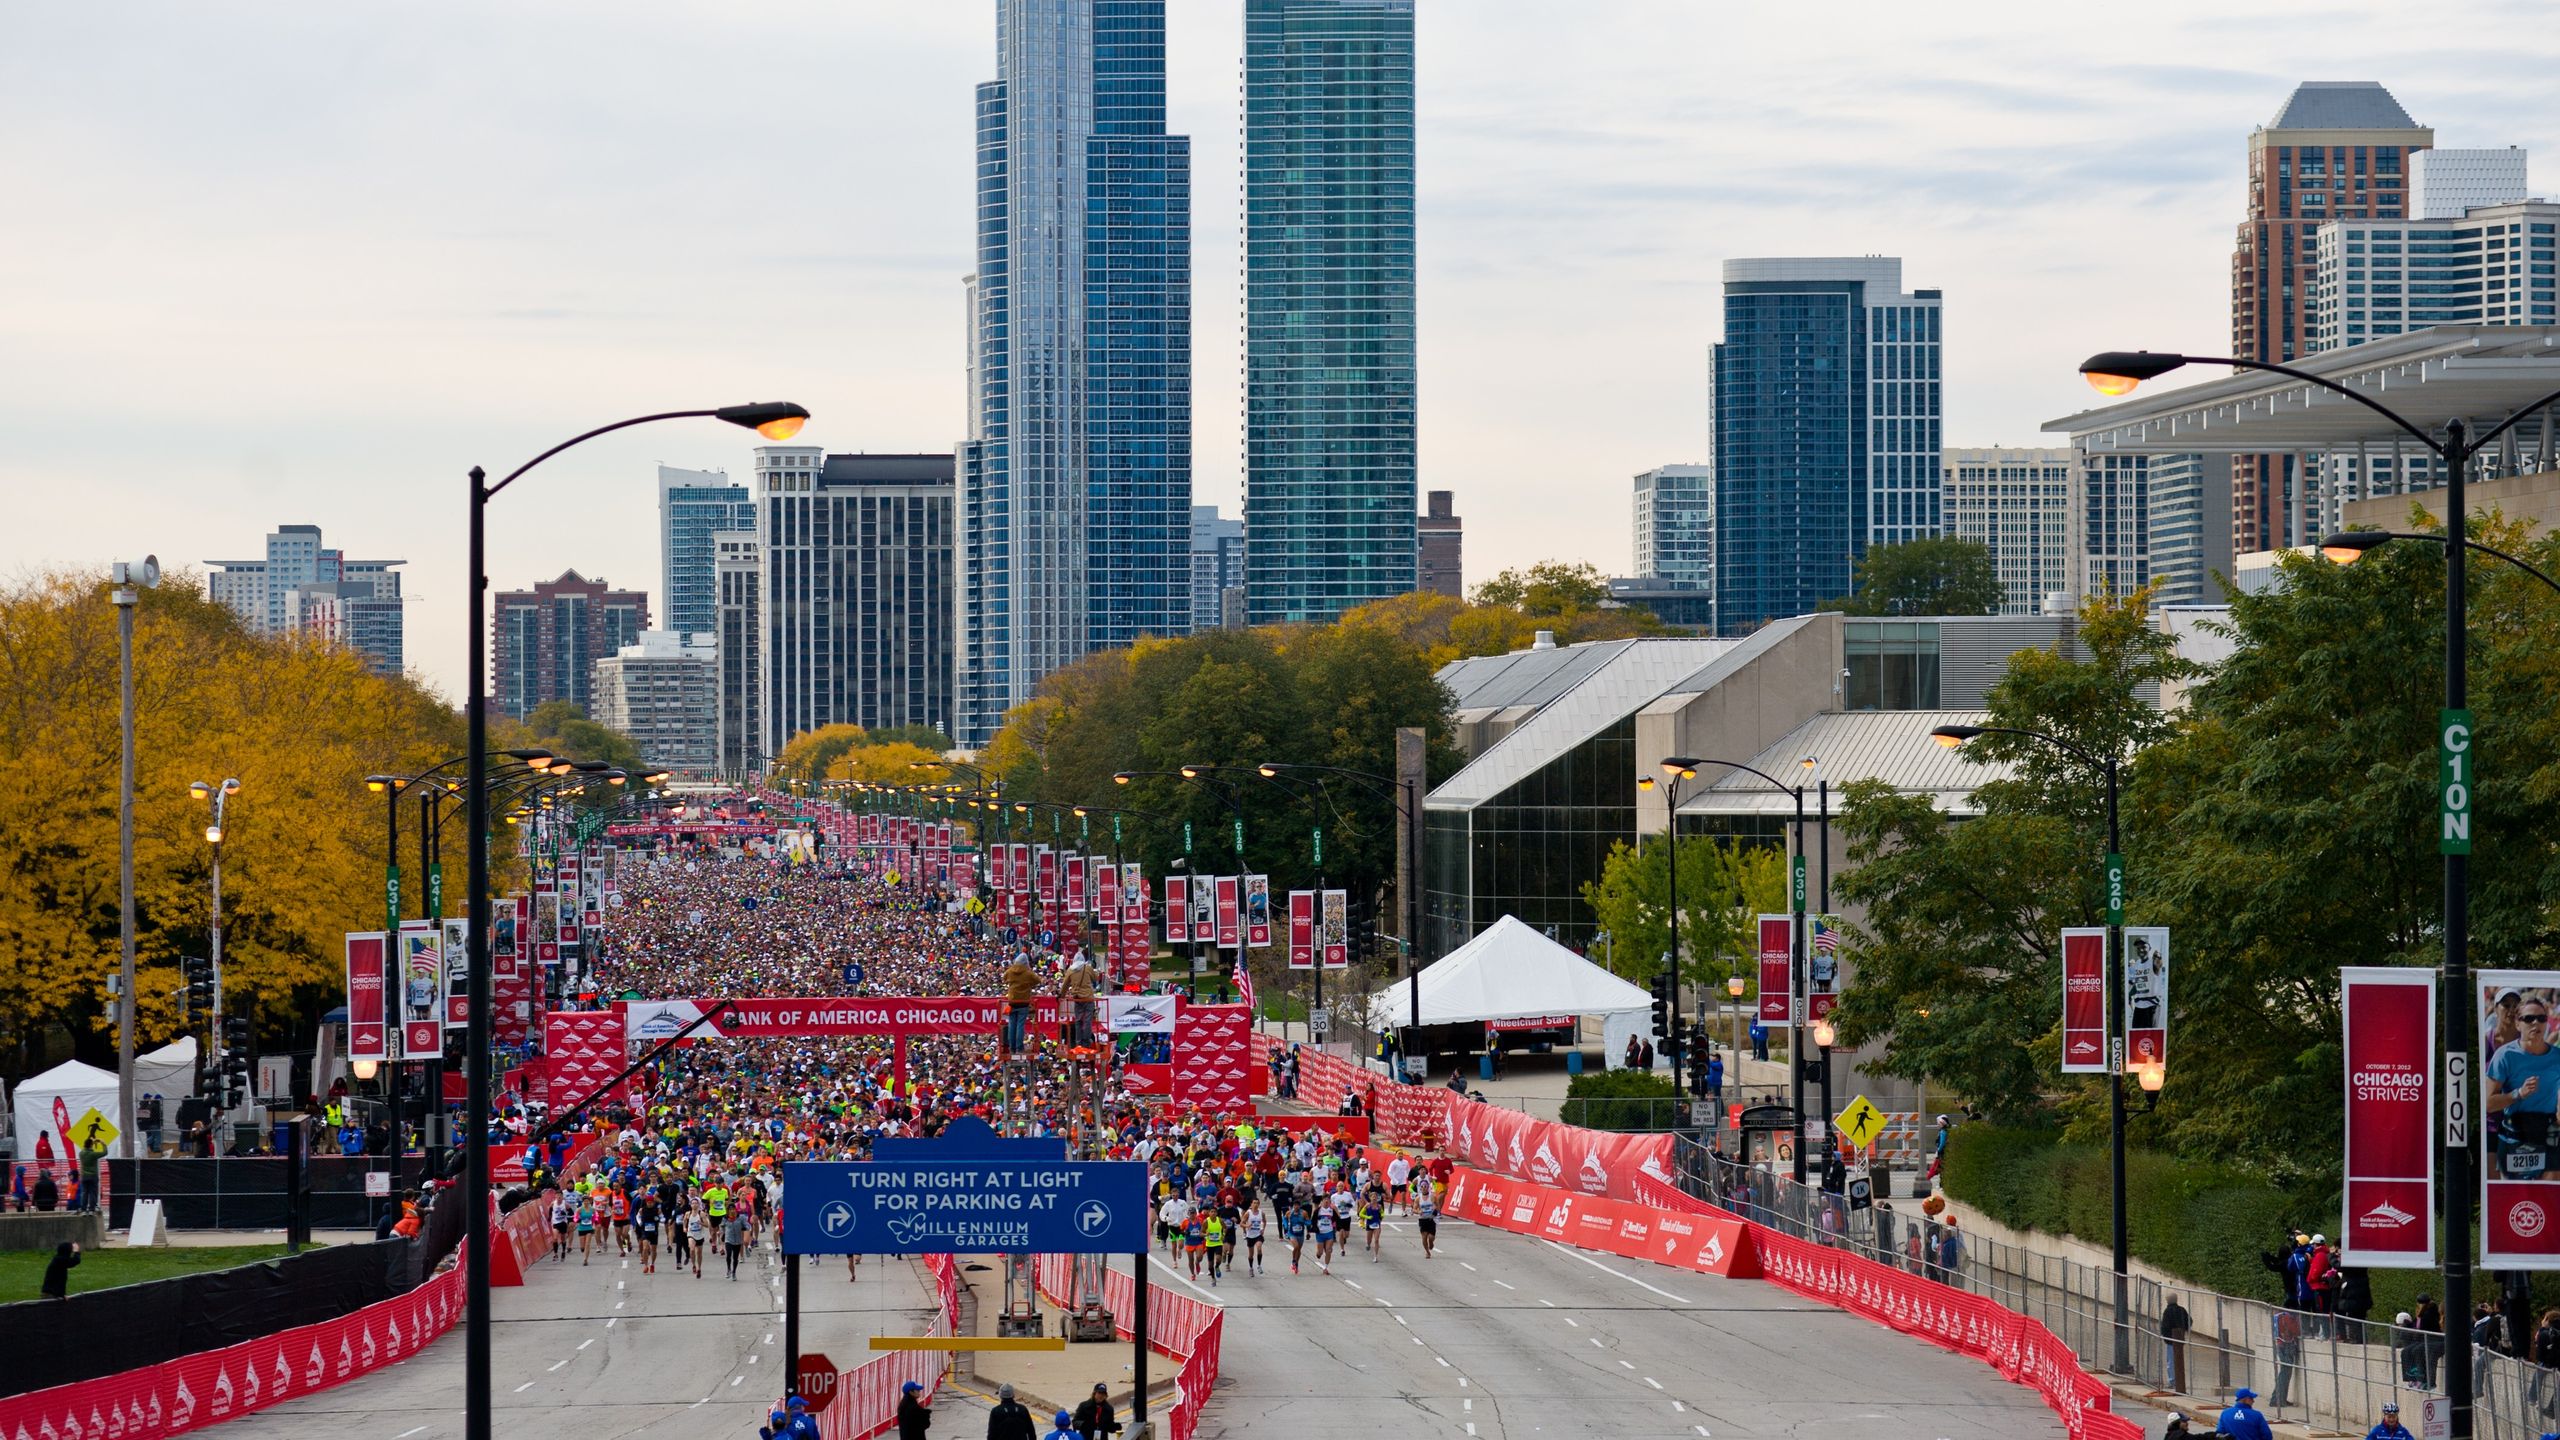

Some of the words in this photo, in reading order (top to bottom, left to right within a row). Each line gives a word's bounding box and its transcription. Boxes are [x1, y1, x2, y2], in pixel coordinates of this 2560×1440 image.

[2444, 724, 2469, 839] C10N
[1235, 822, 1243, 851] C120
[431, 874, 440, 907] C41
[1795, 867, 1805, 901] C30
[2109, 868, 2121, 911] C20
[387, 879, 398, 916] C31
[352, 976, 381, 984] CHICAGO
[850, 969, 857, 978] G
[779, 1011, 802, 1025] OF
[807, 1010, 890, 1025] AMERICA
[896, 1009, 976, 1024] CHICAGO
[1492, 1018, 1543, 1028] Wheelchair
[1546, 1016, 1571, 1025] Start
[1312, 1021, 1326, 1030] 30
[2113, 1040, 2121, 1072] C20
[2353, 1072, 2424, 1087] CHICAGO
[2357, 1087, 2420, 1102] STRIVES
[2449, 1057, 2464, 1142] C10N
[848, 1172, 906, 1188] TURN
[914, 1172, 978, 1188] RIGHT
[985, 1172, 1014, 1188] AT
[1021, 1172, 1083, 1188] LIGHT
[1856, 1184, 1866, 1195] 1K
[874, 1194, 918, 1210] FOR
[926, 1194, 1022, 1210] PARKING
[1028, 1194, 1058, 1210] AT
[914, 1222, 1029, 1234] MILLENNIUM
[956, 1236, 1029, 1246] GARAGES
[798, 1372, 835, 1394] TOP
